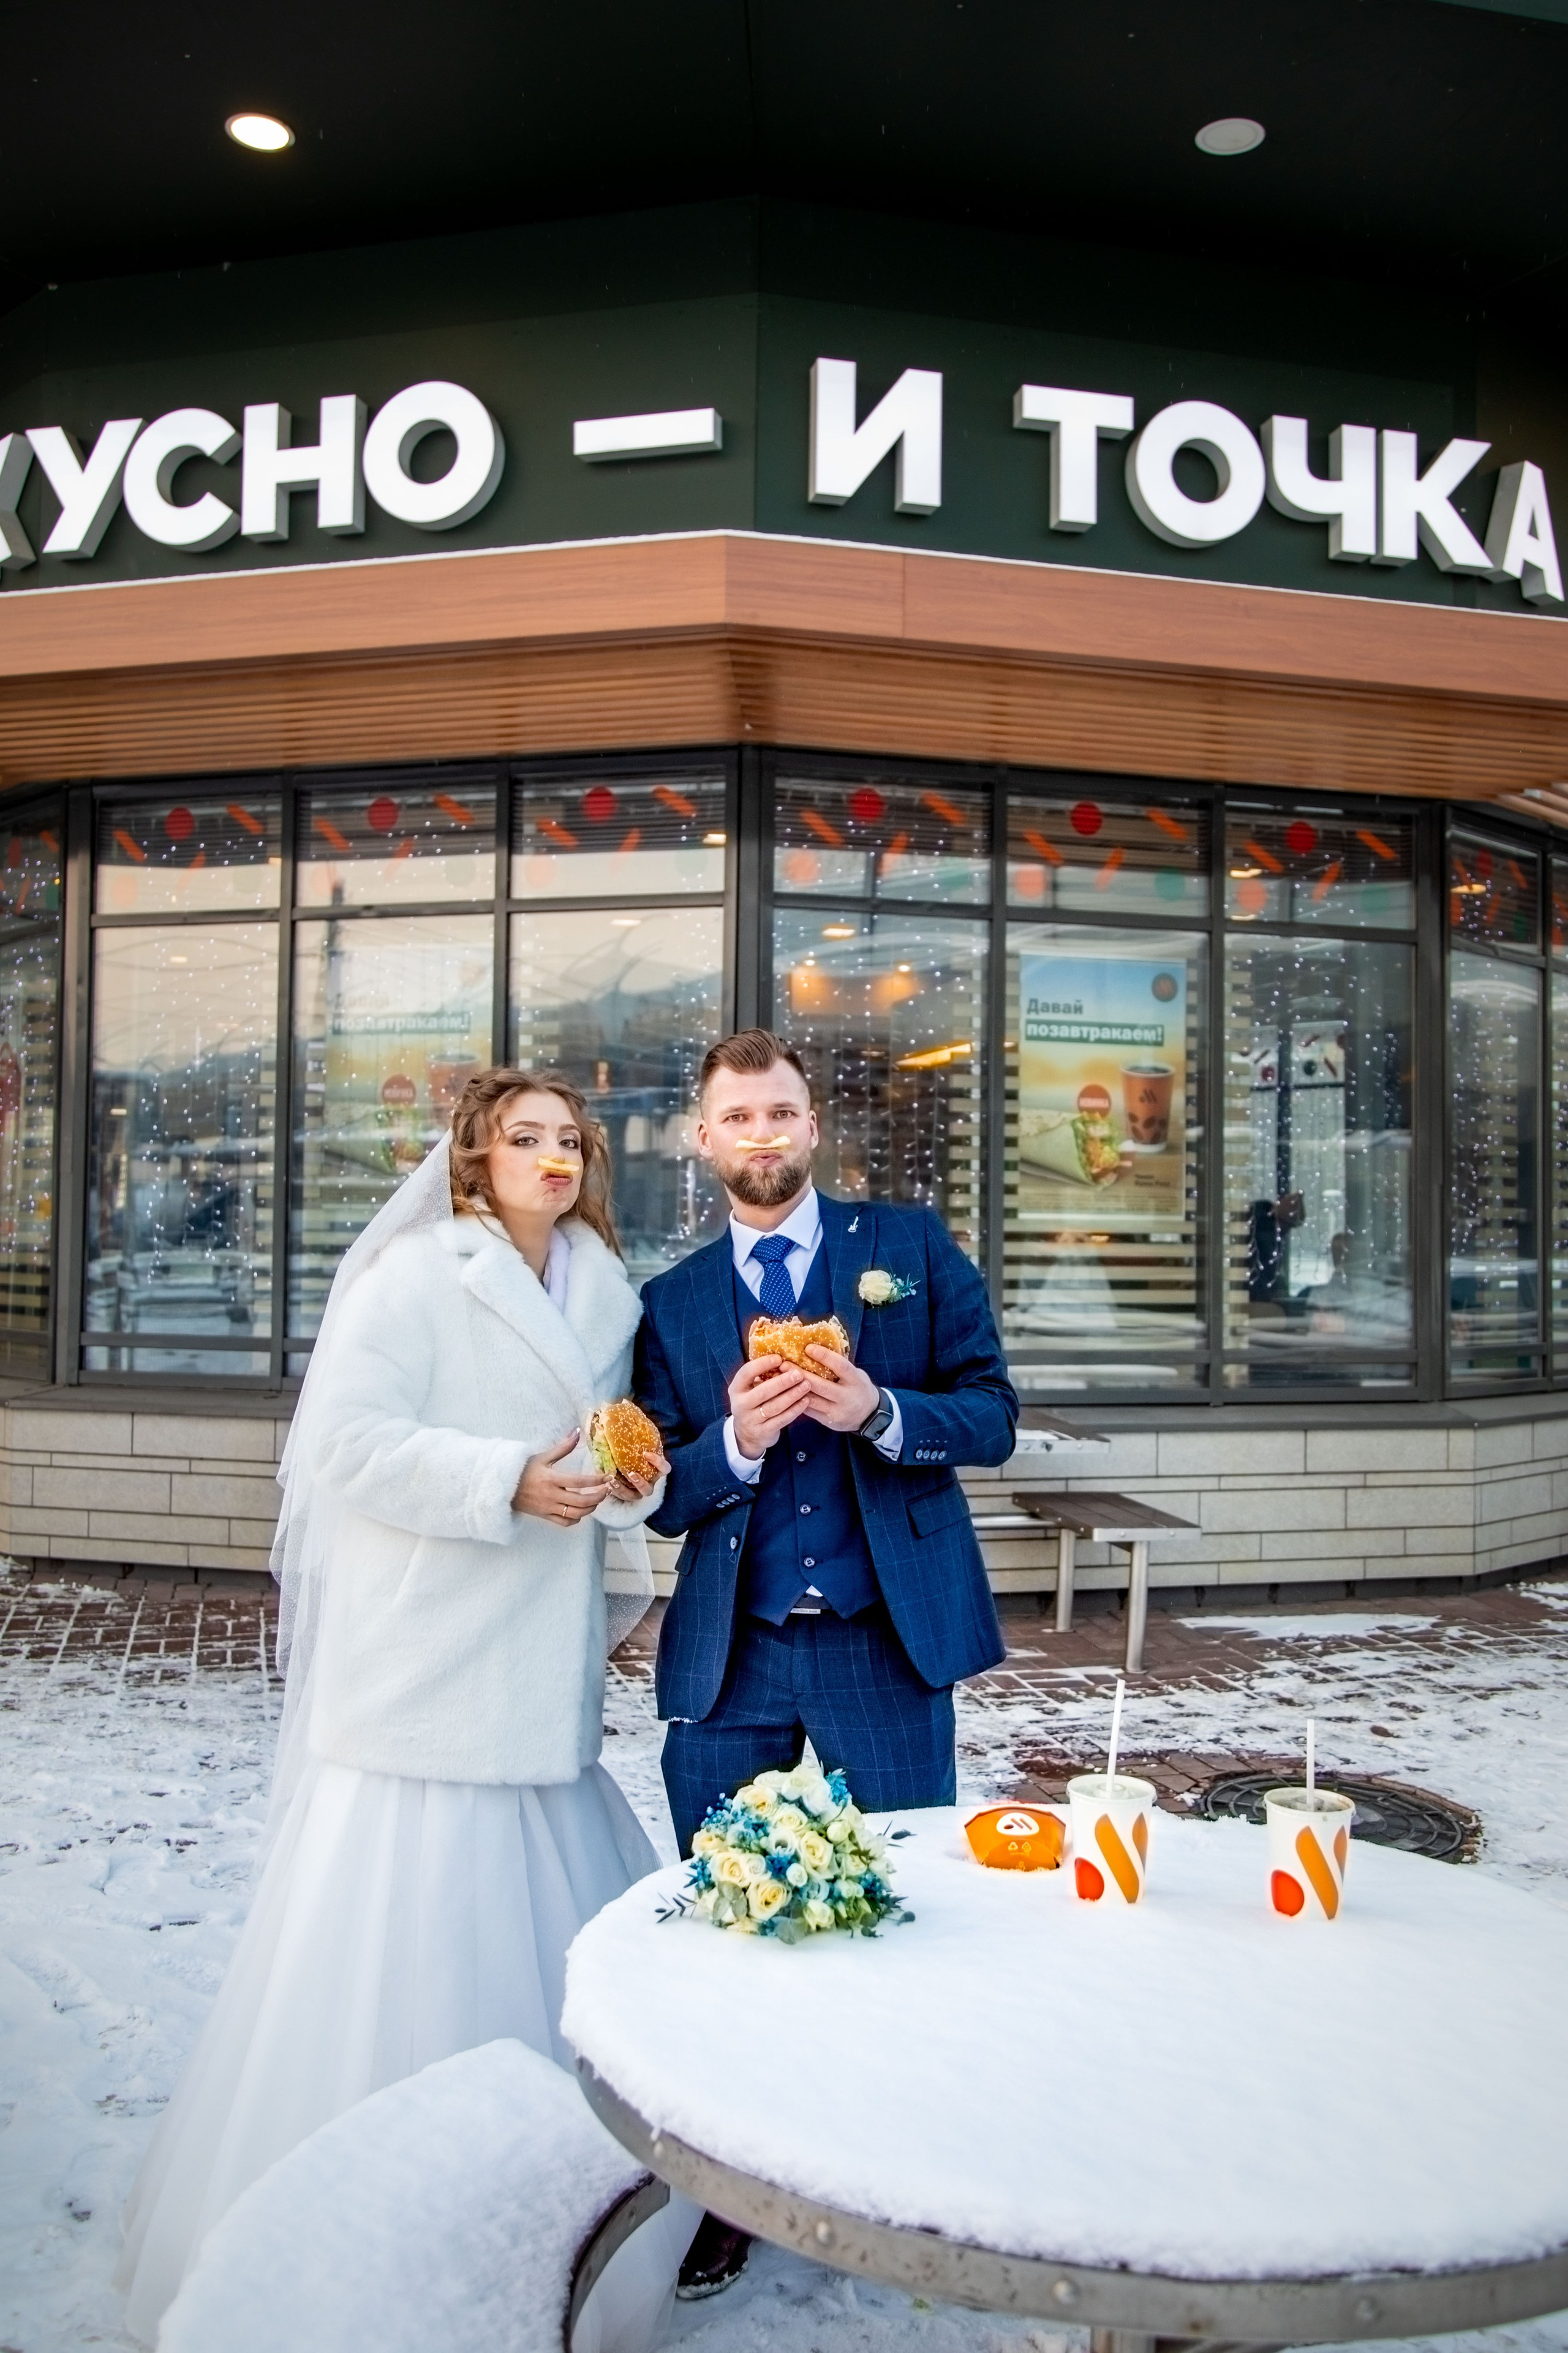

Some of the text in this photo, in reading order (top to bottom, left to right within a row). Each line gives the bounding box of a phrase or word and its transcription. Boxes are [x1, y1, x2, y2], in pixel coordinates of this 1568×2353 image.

[809, 357, 943, 516] И
[1013, 383, 1566, 606] ТОЧКА
[1027, 998, 1084, 1014] Давай
[1027, 1024, 1163, 1041] позавтракаем!
